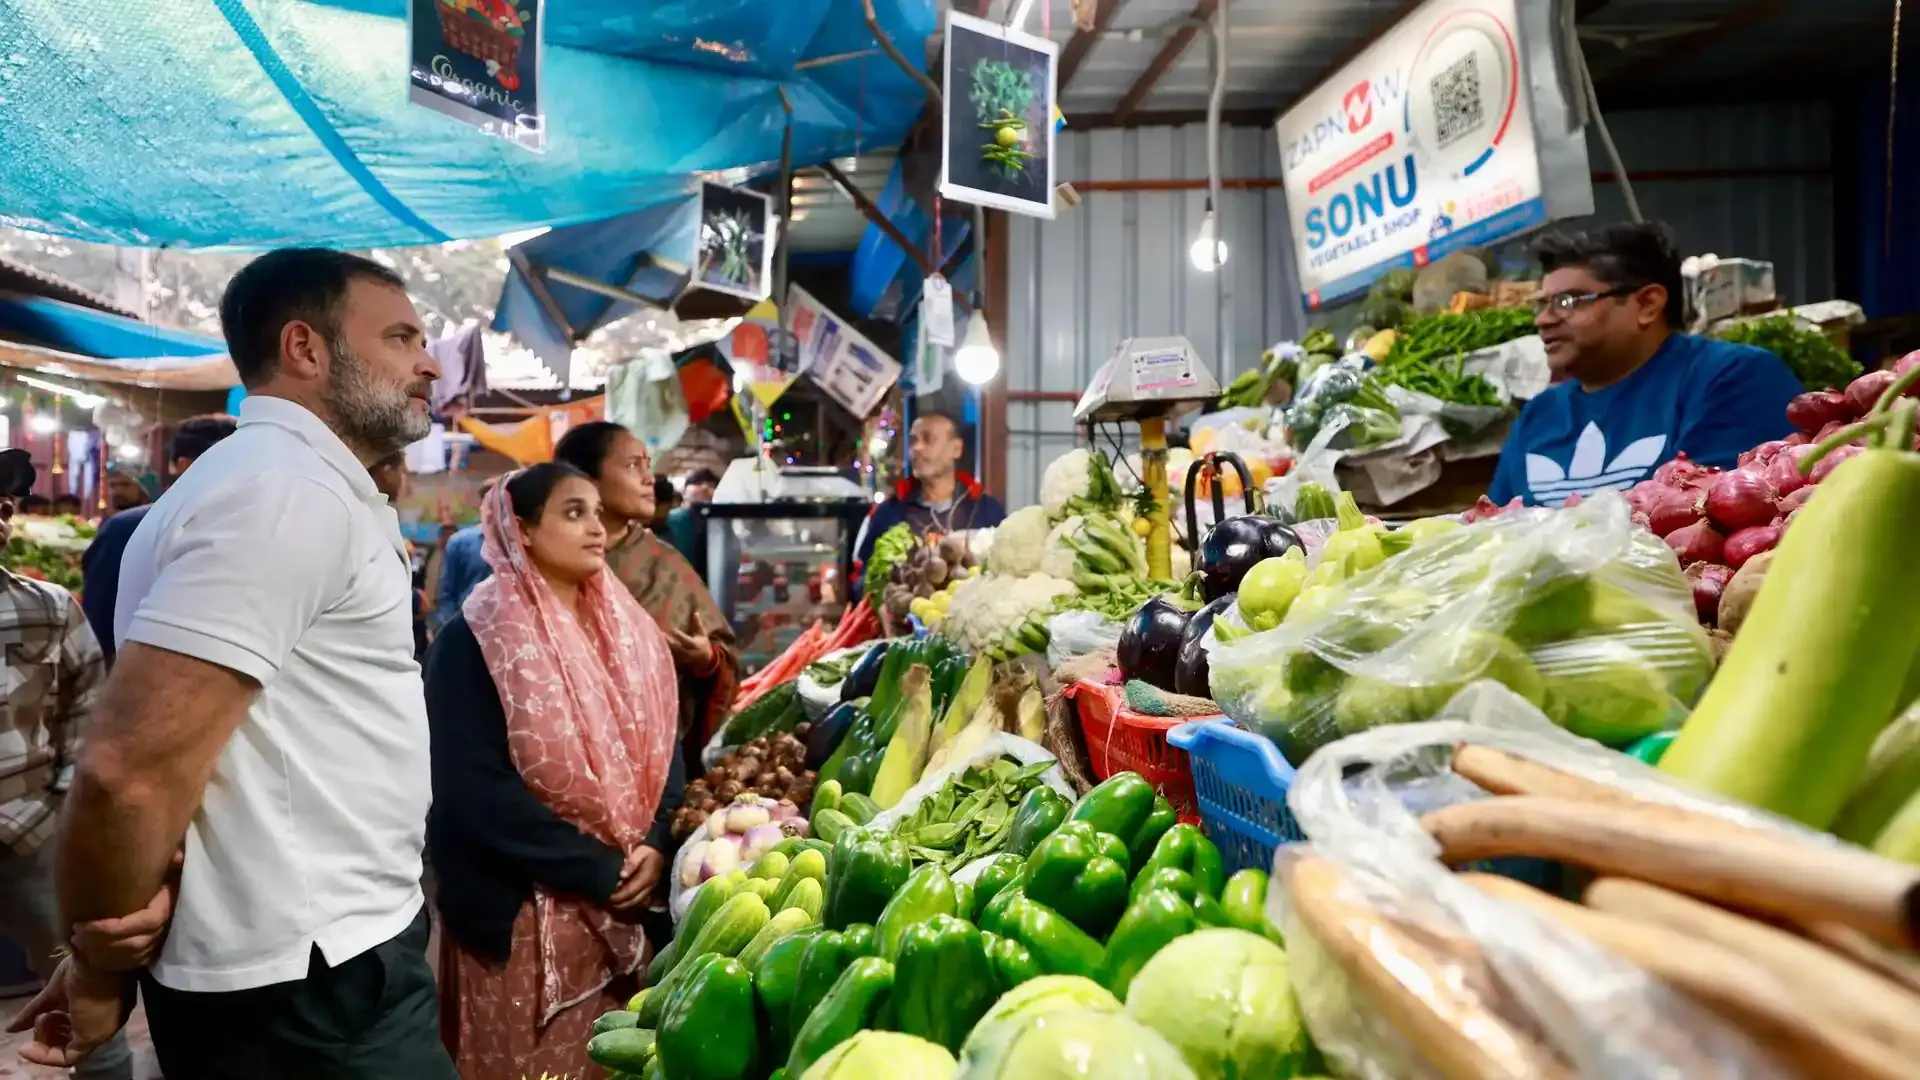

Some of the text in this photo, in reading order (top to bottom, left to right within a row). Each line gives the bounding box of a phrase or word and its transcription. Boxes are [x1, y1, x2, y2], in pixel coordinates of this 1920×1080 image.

[431, 54, 524, 112] Organic
[1305, 154, 1417, 249] SONU
[1310, 227, 1377, 268] VEGETABLE
[1383, 208, 1421, 236] SHOP
